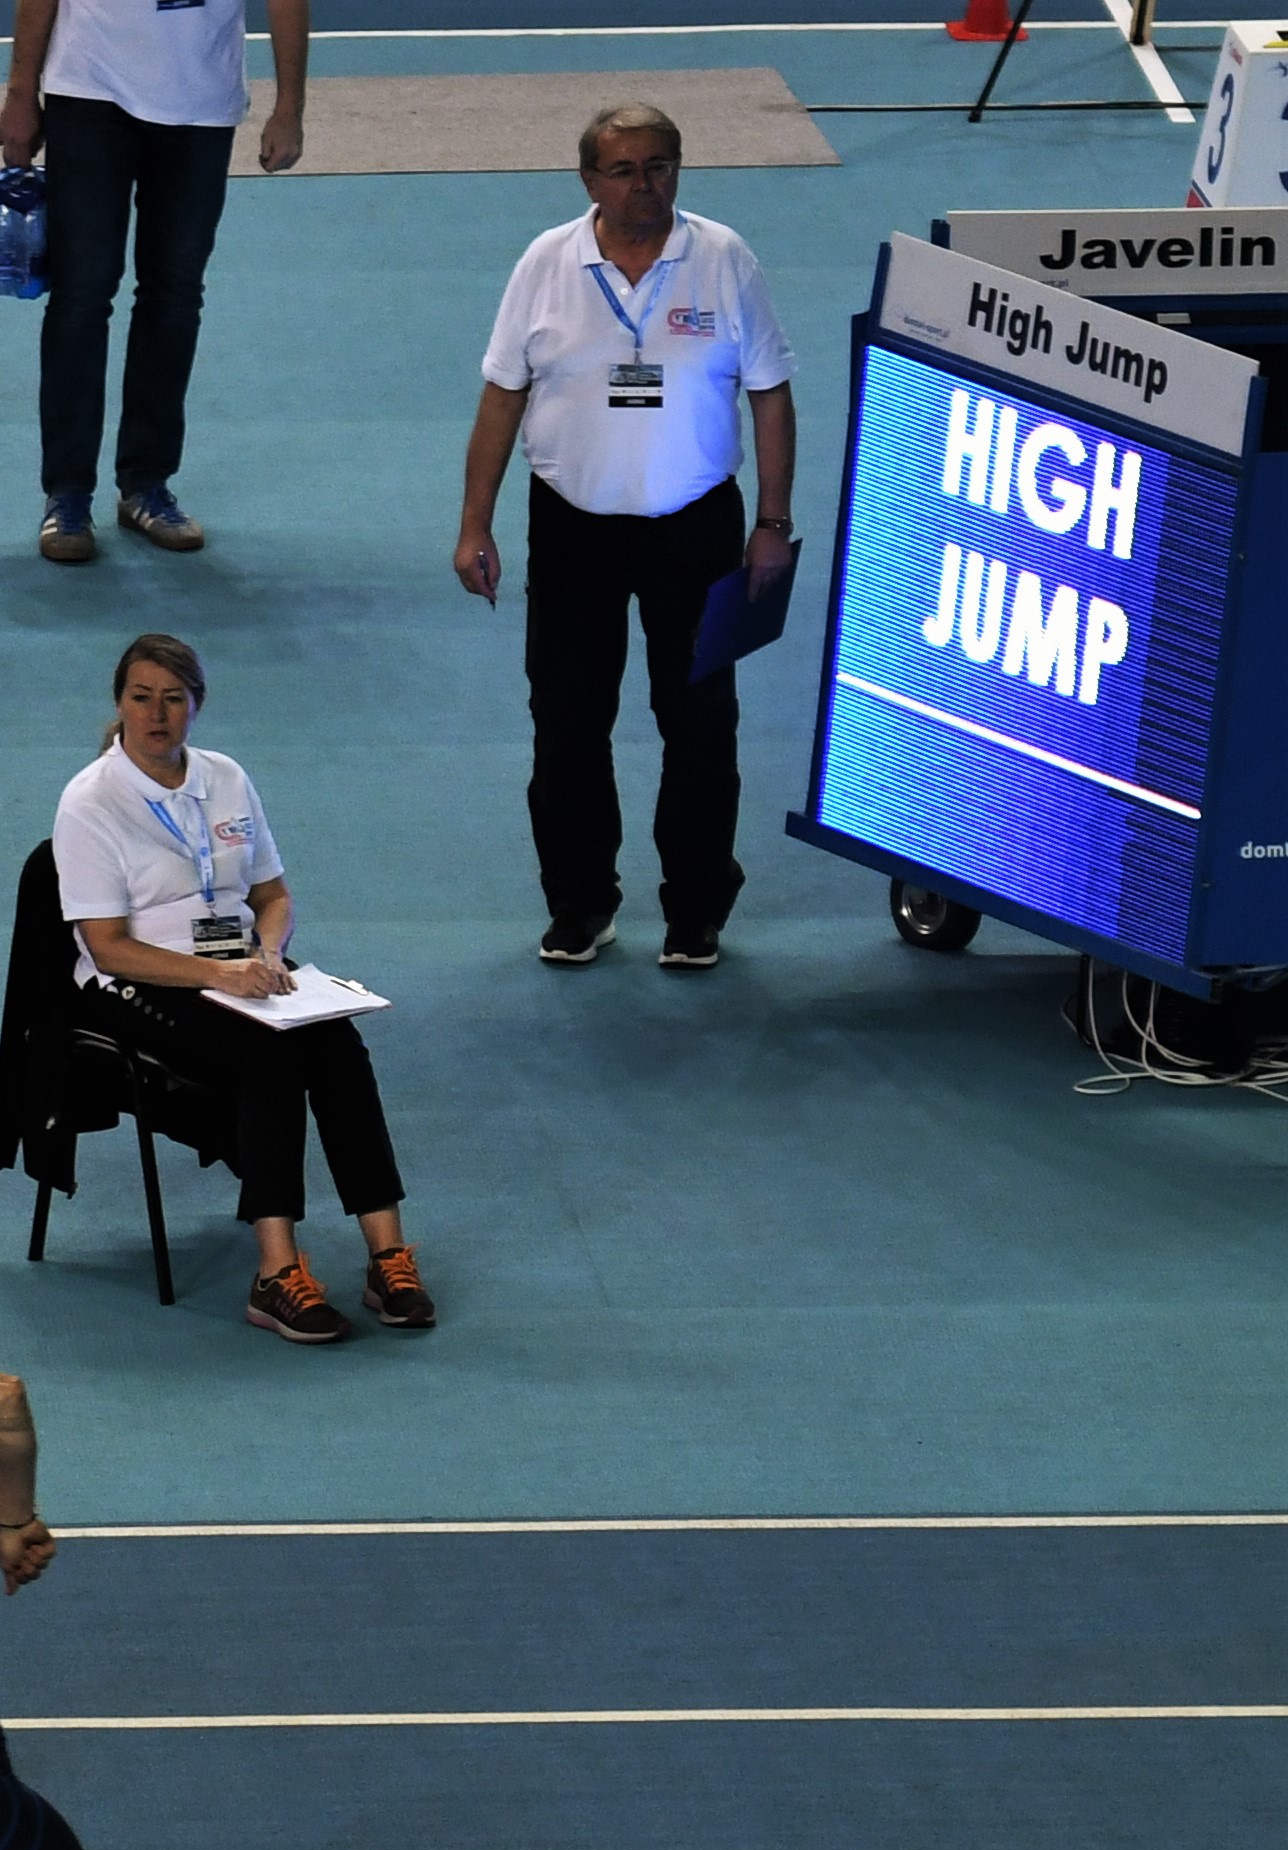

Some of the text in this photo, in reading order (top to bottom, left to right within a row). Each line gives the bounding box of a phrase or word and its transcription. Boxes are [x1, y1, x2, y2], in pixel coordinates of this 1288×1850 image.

[1207, 73, 1235, 184] 3
[1039, 227, 1276, 270] Javelin
[967, 282, 1168, 403] High Jump
[941, 387, 1143, 560] HIGH
[922, 541, 1130, 705] JUMP
